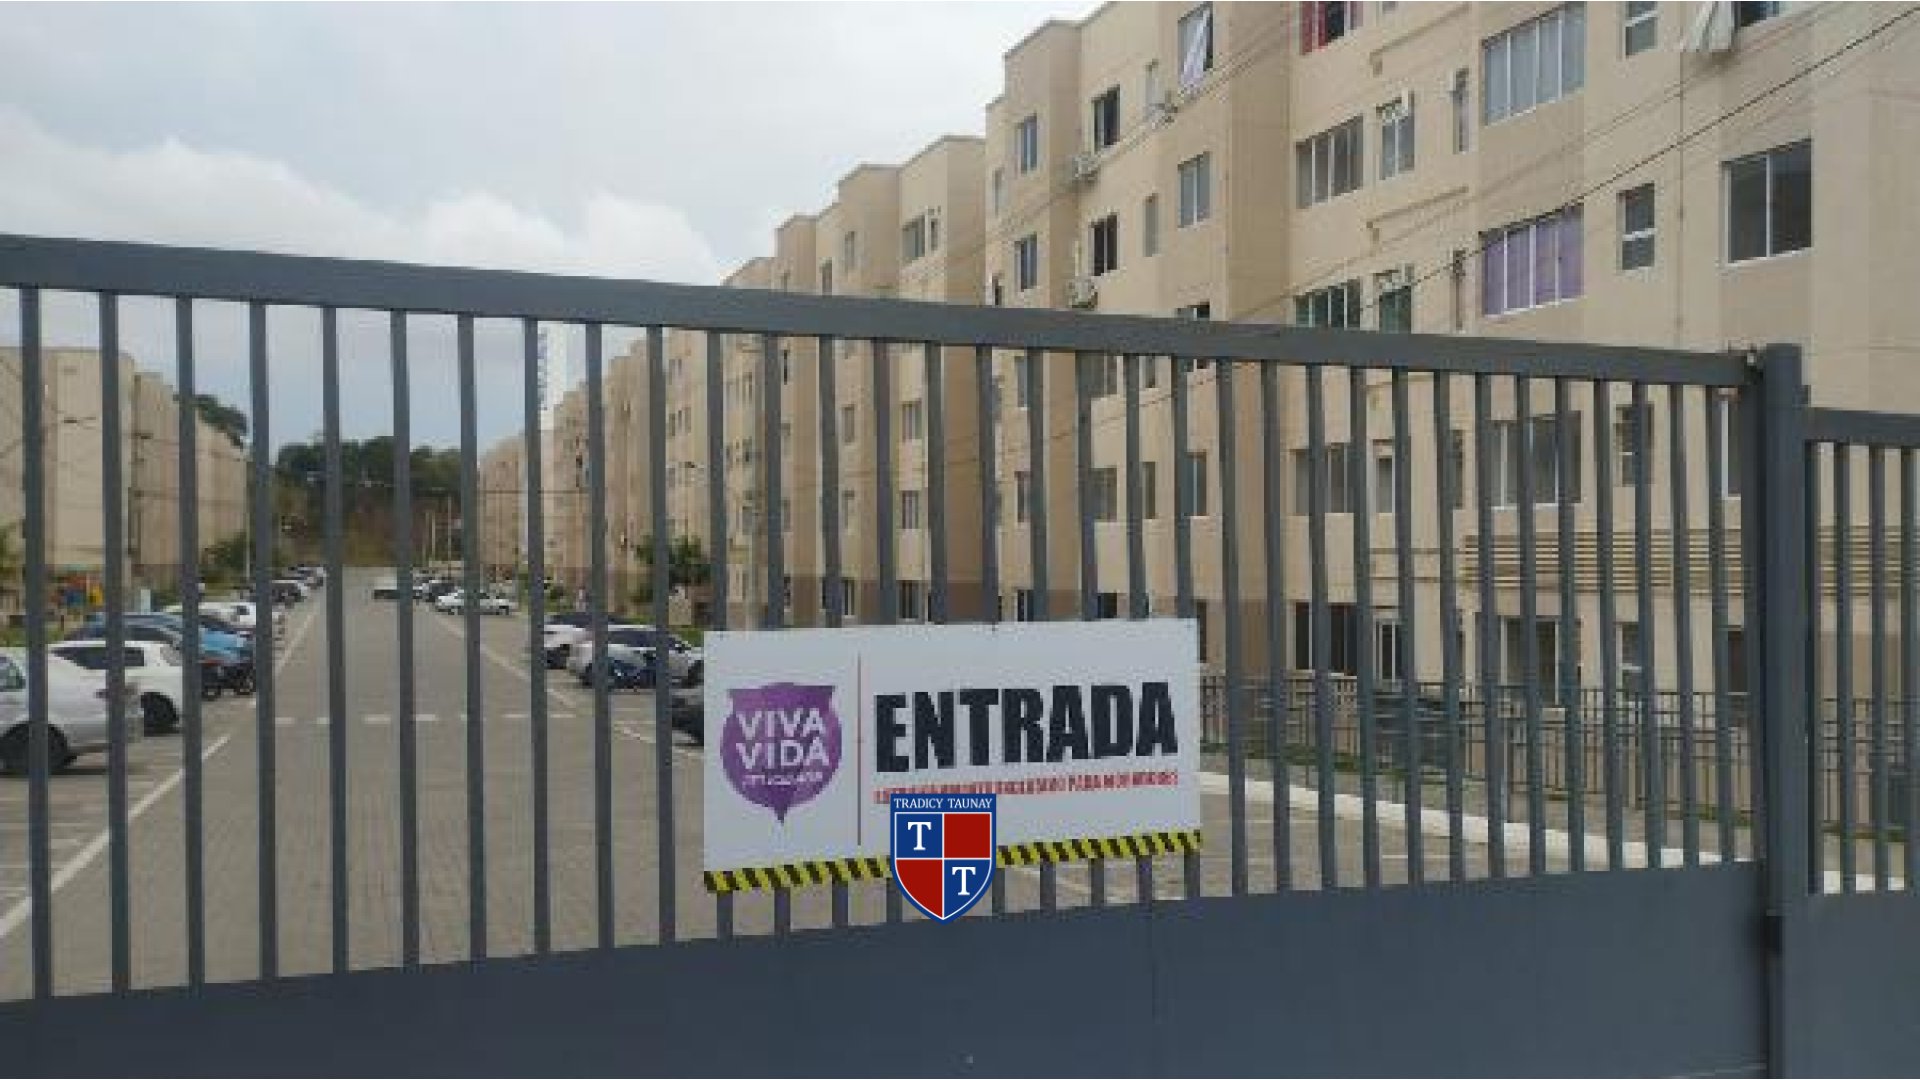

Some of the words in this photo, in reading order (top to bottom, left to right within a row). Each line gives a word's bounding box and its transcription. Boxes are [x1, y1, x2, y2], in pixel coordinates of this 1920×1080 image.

[735, 708, 826, 739] VIVA
[875, 682, 1178, 772] ENTRADA
[735, 738, 830, 770] VIDA
